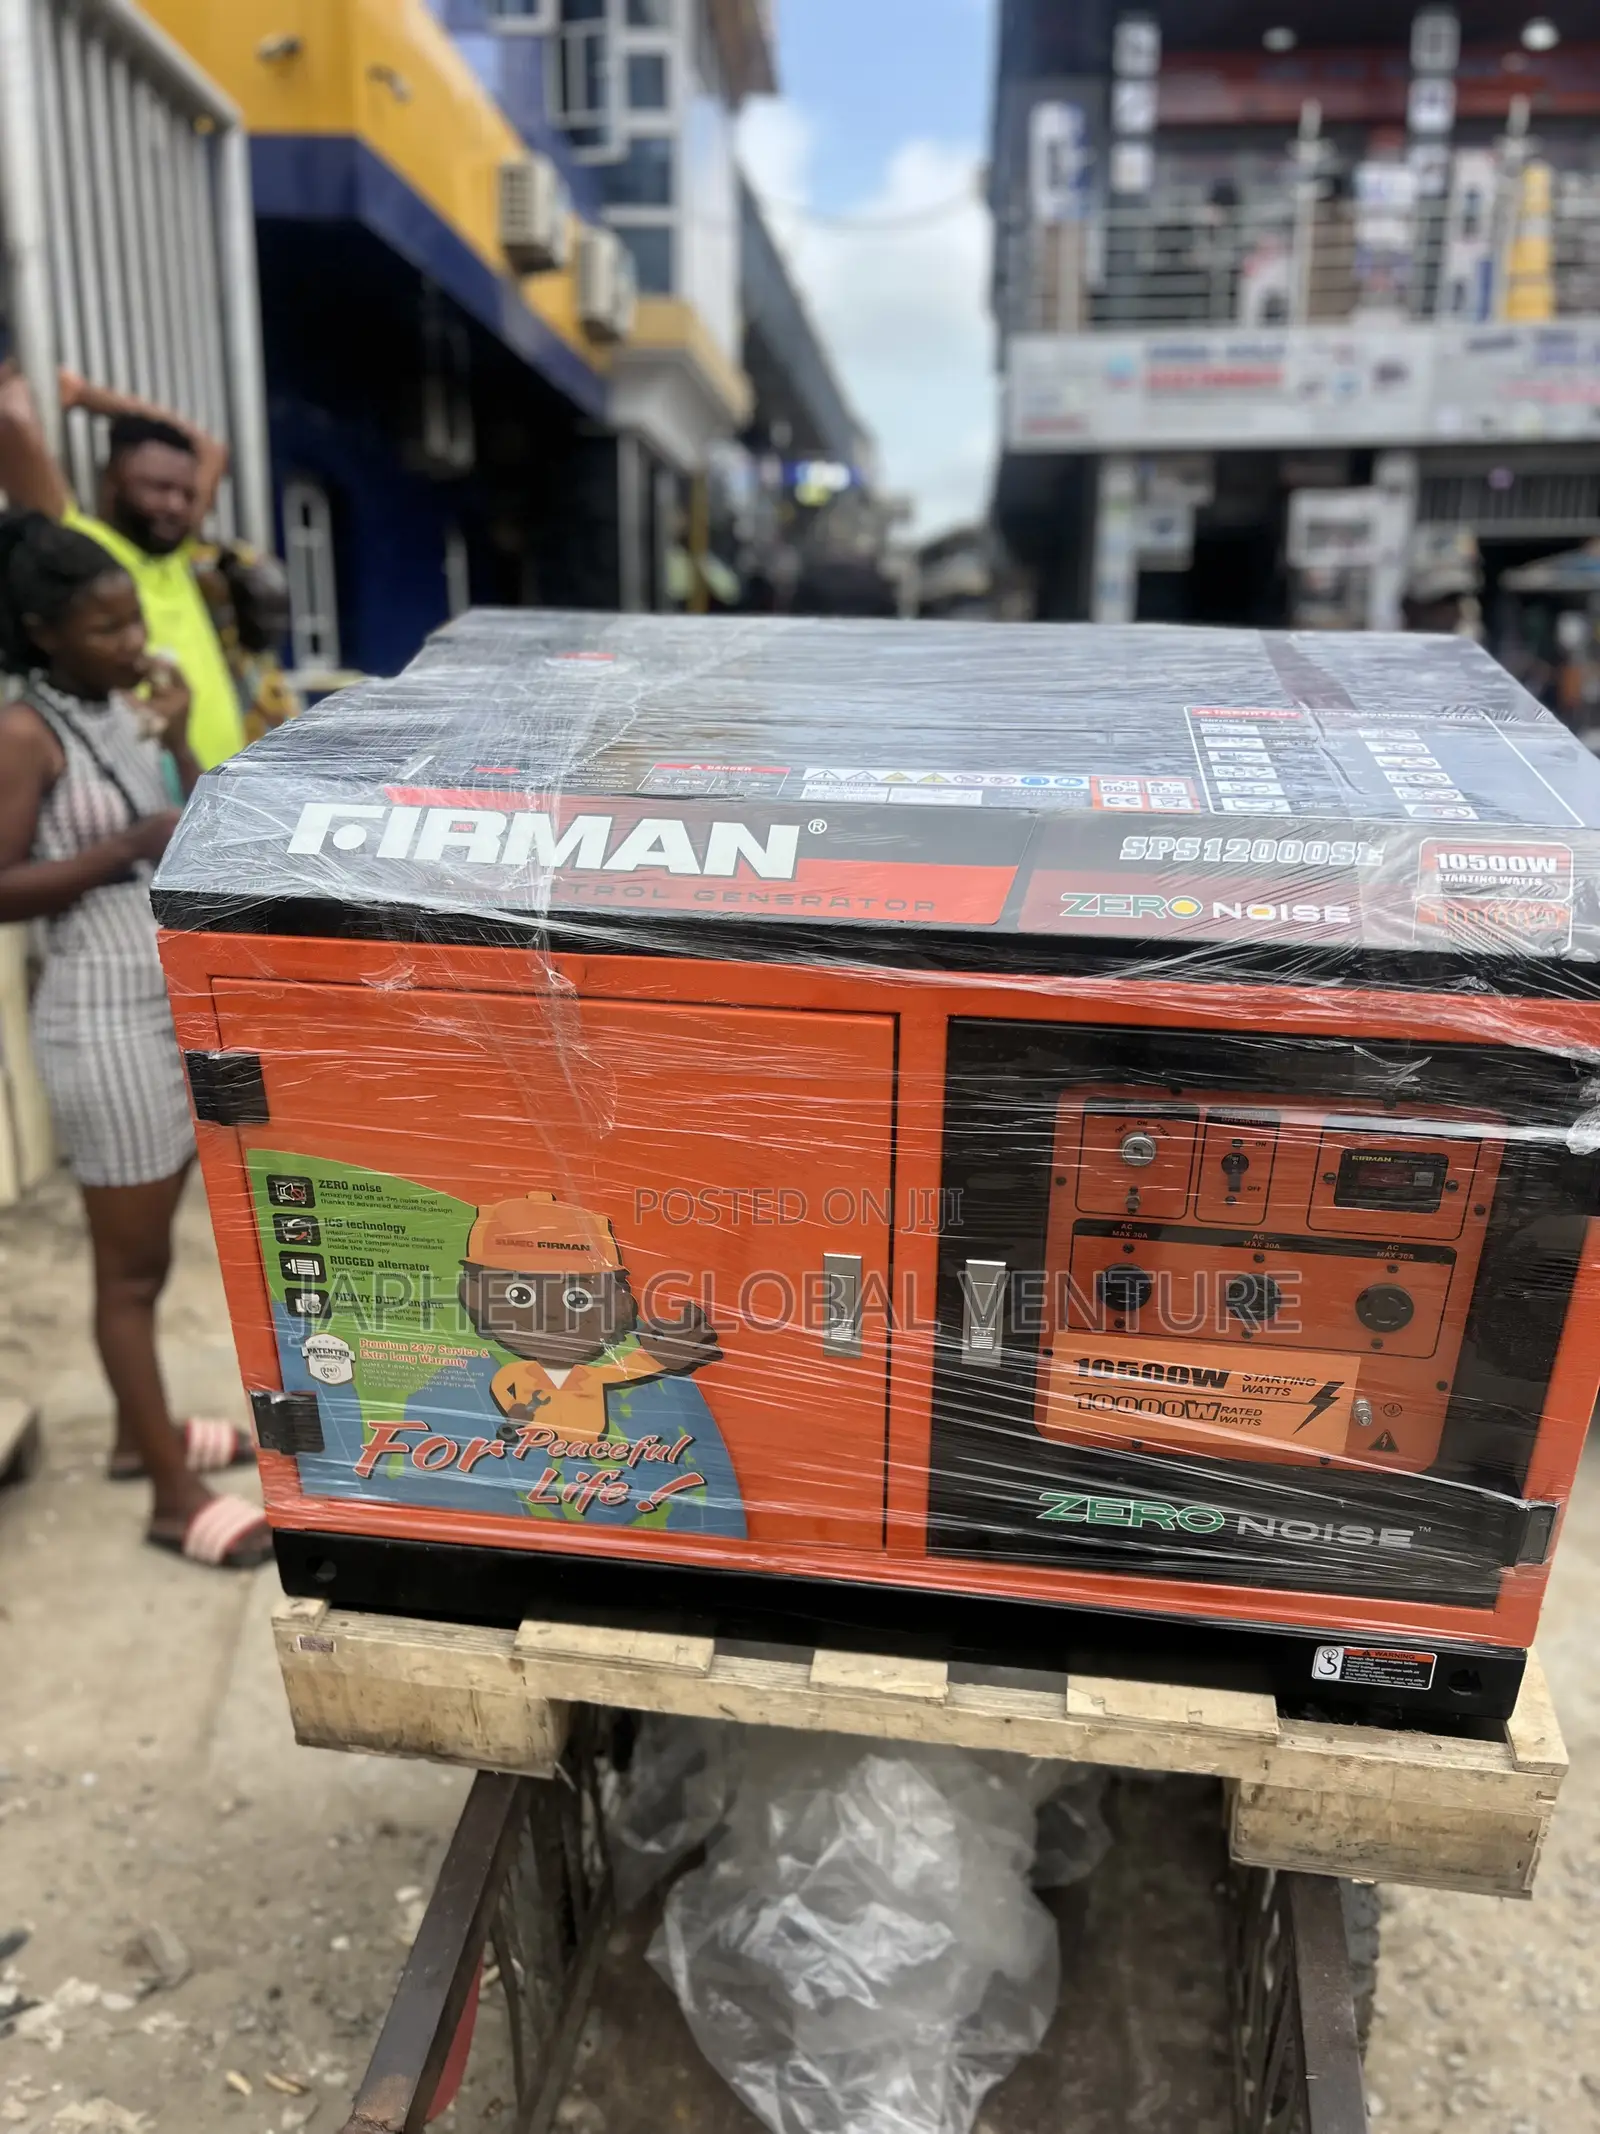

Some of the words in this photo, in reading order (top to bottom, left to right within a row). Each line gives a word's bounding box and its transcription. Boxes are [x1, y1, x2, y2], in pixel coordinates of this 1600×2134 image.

[286, 802, 801, 880] FIRMAN
[1119, 836, 1386, 866] SPS12000SE
[1435, 853, 1558, 874] 10500W
[1435, 873, 1497, 884] STARTING
[1499, 876, 1543, 886] WATTS
[693, 889, 936, 913] GENERATOR
[1061, 893, 1203, 920] ZERO
[1212, 901, 1351, 924] NOISE
[1114, 1123, 1128, 1134] OFF
[319, 1179, 349, 1190] ZERO
[352, 1182, 382, 1193] noise
[320, 1191, 351, 1201] Amazing
[320, 1198, 346, 1206] thanks
[428, 1206, 453, 1214] design
[323, 1217, 343, 1228] ICS
[346, 1219, 406, 1234] technology
[1112, 1230, 1131, 1238] MAX
[364, 1246, 390, 1254] canopy
[495, 1238, 535, 1248] SUMEC
[537, 1241, 591, 1252] FIRMAN
[1243, 1240, 1263, 1248] MAX
[1264, 1242, 1280, 1250] 30A
[329, 1255, 375, 1267] RUGGED
[377, 1259, 430, 1272] alternator
[1398, 1252, 1414, 1260] 30A
[334, 1291, 405, 1306] HEAVY-DUTY
[306, 1347, 350, 1358] PATENTED
[359, 1338, 408, 1351] Premium
[410, 1341, 435, 1354] 24/7
[438, 1344, 479, 1357] Service
[480, 1347, 490, 1359] &
[360, 1349, 388, 1360] Extra
[389, 1351, 417, 1365] Long
[418, 1353, 468, 1369] Warranty
[1073, 1357, 1231, 1390] 10500W
[1241, 1373, 1317, 1387] STARTING
[1241, 1384, 1292, 1397] WATTS
[1074, 1392, 1223, 1421] 10000W
[1220, 1405, 1263, 1417] RATED
[1218, 1415, 1262, 1427] WATTS
[354, 1419, 506, 1479] For
[512, 1426, 695, 1470] Peaceful
[1036, 1492, 1226, 1534] ZERO
[1236, 1515, 1415, 1549] NOISE
[1374, 1650, 1416, 1660] WARNING
